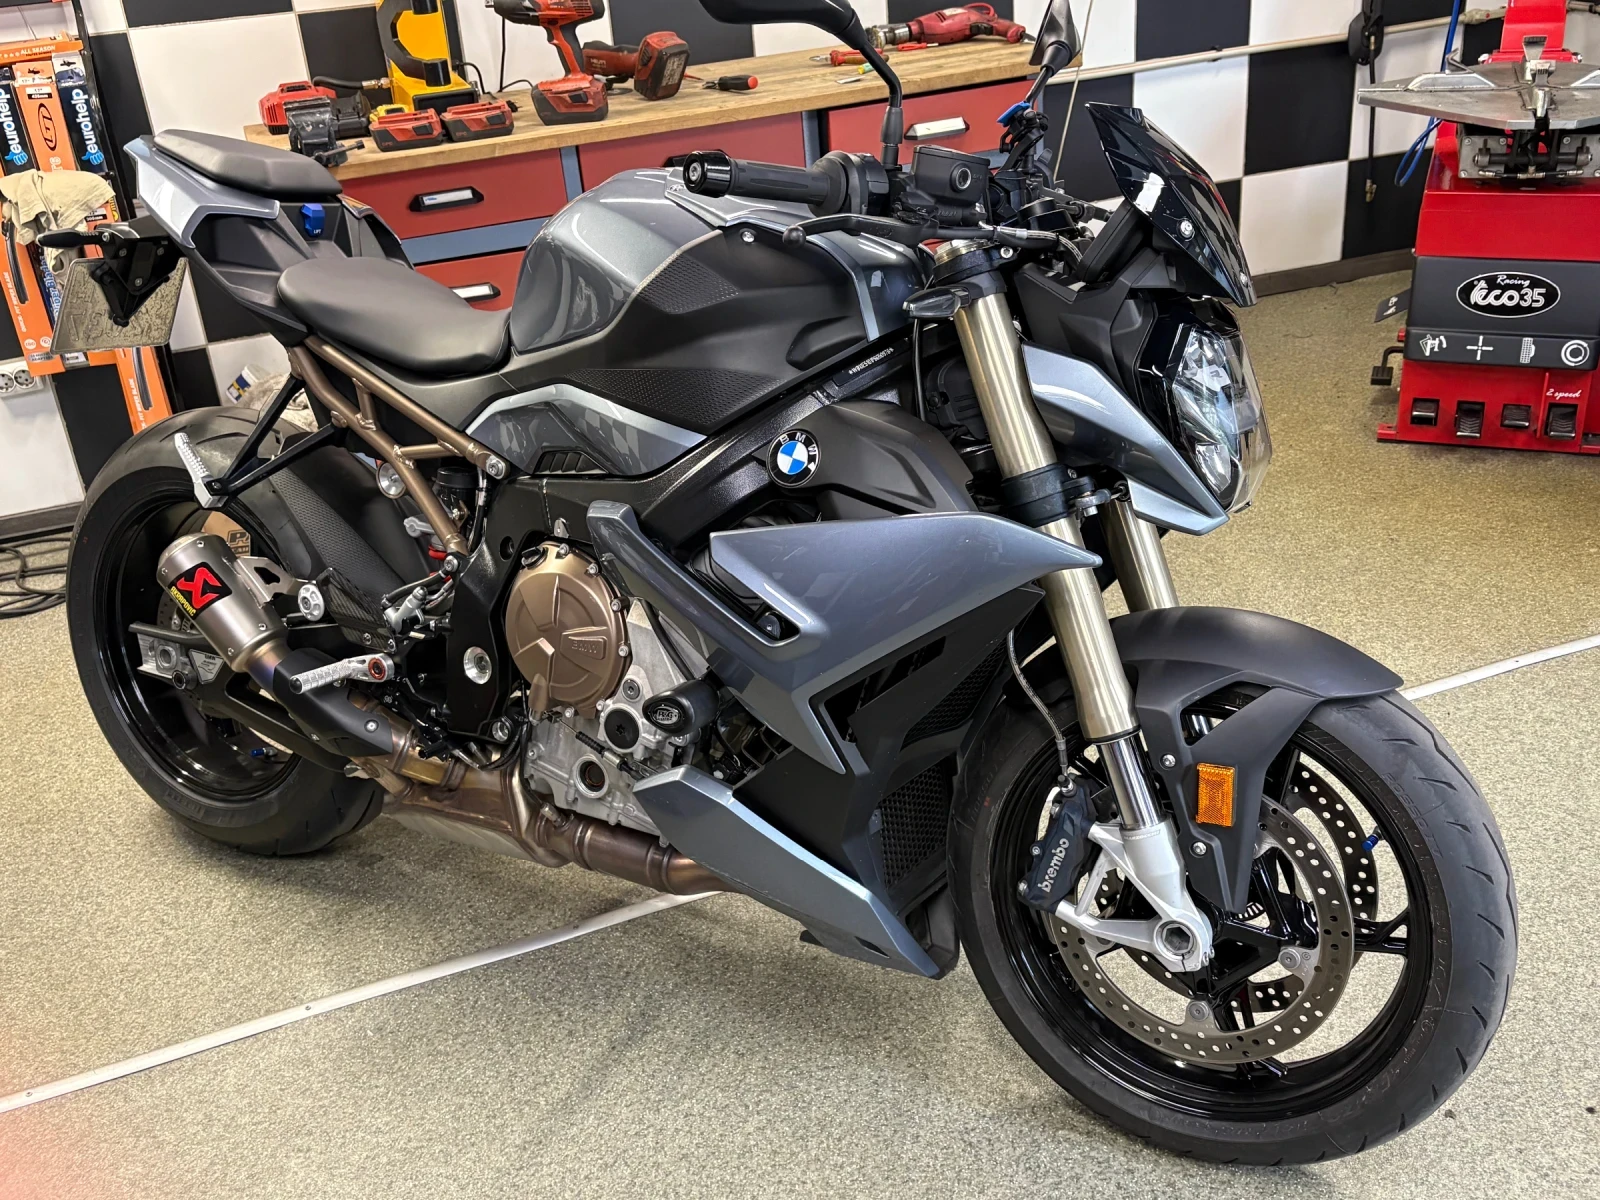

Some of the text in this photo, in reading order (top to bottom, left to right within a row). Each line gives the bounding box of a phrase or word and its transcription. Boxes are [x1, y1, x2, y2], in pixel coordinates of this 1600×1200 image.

[71, 88, 98, 153] eurohelp
[1496, 274, 1531, 288] Racing
[1553, 389, 1582, 401] speed
[779, 432, 818, 456] BMW
[657, 709, 674, 719] R&G
[1037, 838, 1070, 893] brembo
